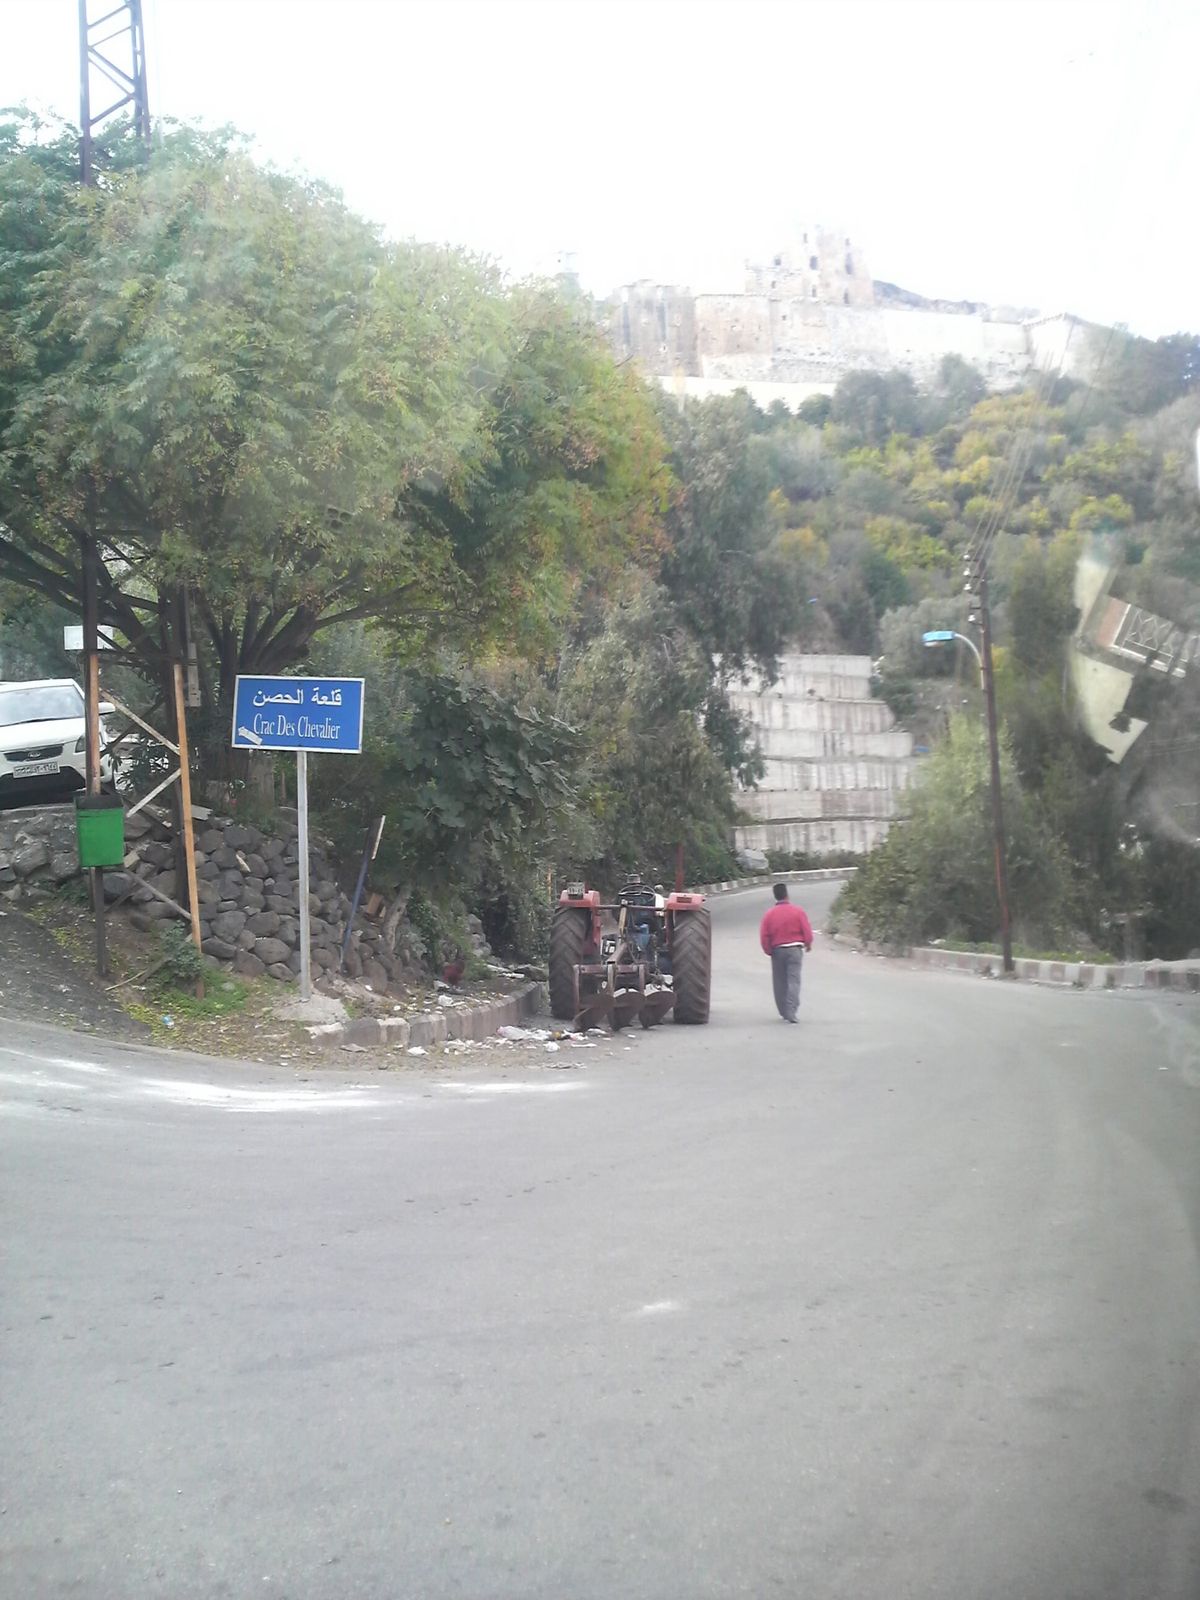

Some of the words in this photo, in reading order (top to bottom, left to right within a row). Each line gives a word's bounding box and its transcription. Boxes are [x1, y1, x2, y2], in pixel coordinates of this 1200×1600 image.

[253, 688, 304, 707] الحصن
[311, 687, 342, 706] قلعة
[253, 713, 275, 735] Crac
[277, 715, 295, 737] Des
[297, 716, 341, 739] Chevalier
